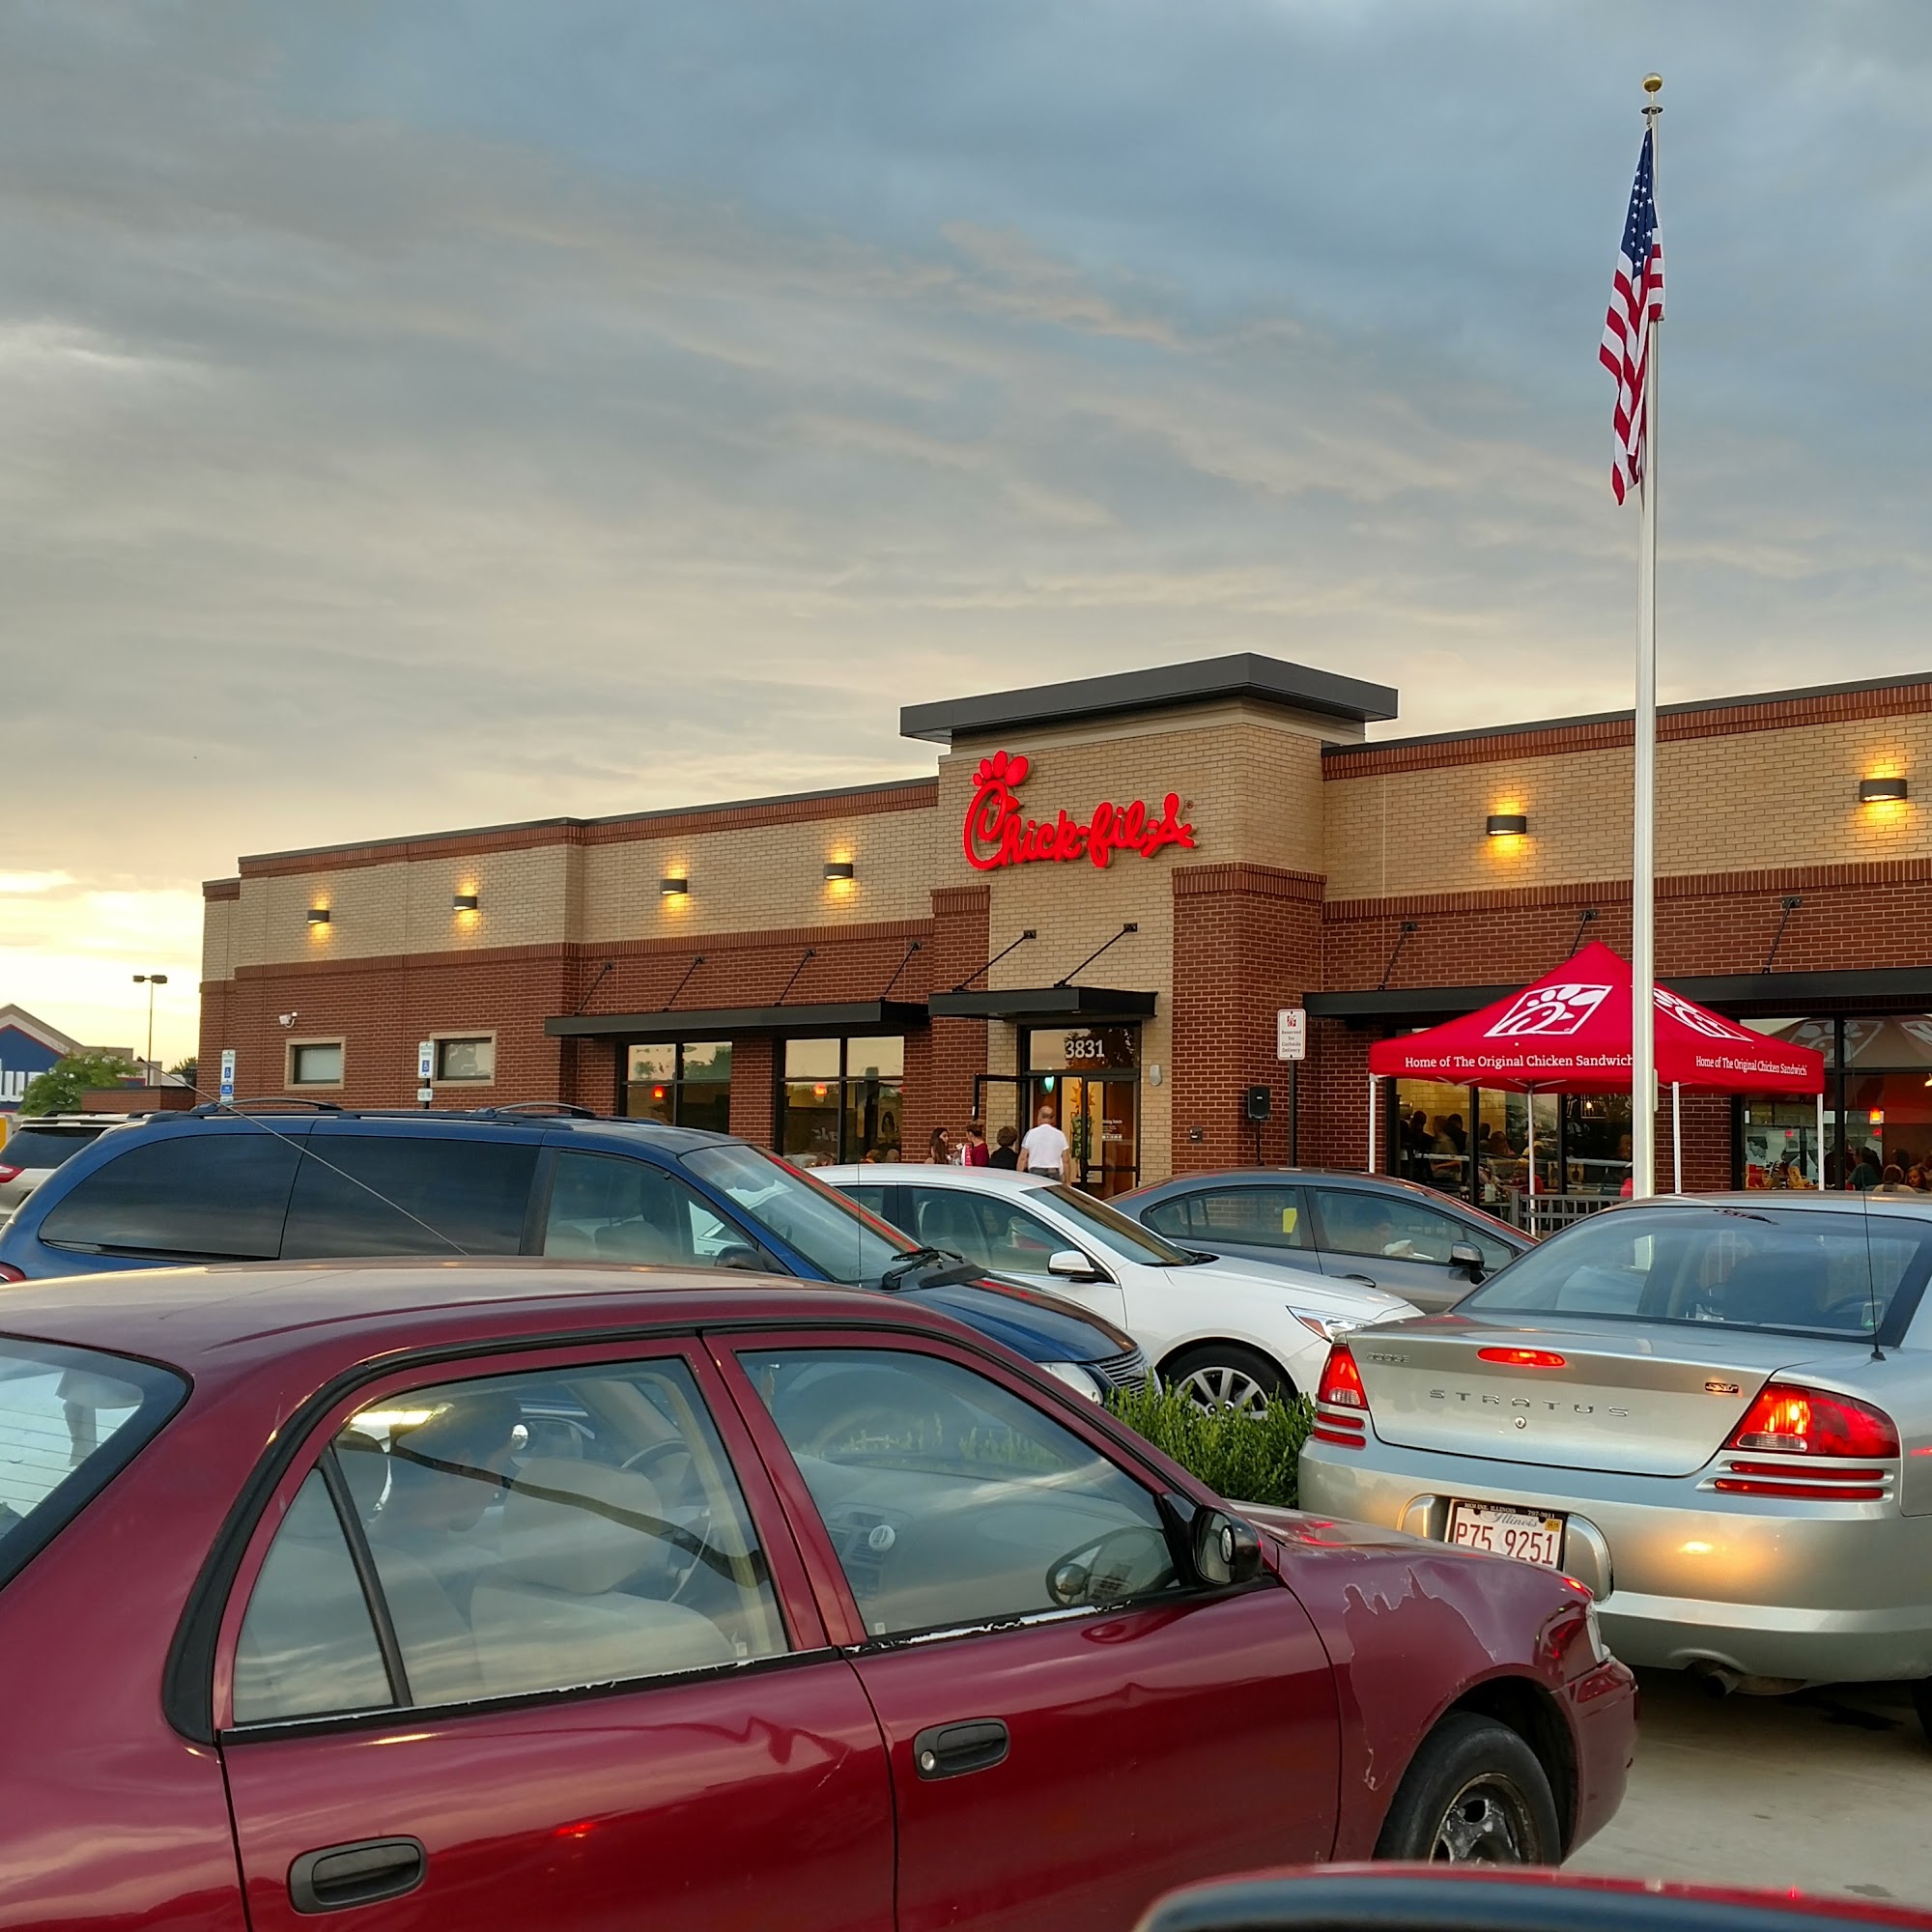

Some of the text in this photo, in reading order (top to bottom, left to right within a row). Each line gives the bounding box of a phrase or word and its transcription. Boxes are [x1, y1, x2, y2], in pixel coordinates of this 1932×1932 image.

[963, 779, 1195, 870] Chick-fil-A
[1065, 1039, 1105, 1059] 3831
[1405, 1057, 1437, 1068] Home
[1438, 1055, 1452, 1067] of
[1453, 1055, 1476, 1067] The
[1477, 1054, 1524, 1070] Original
[1525, 1054, 1574, 1066] Chicken
[1695, 1055, 1807, 1076] Home of The Original Chicken Sandwich
[1430, 1388, 1629, 1418] STRATUS
[1479, 1512, 1538, 1527] Illinois
[1456, 1522, 1553, 1565] P75 9251
